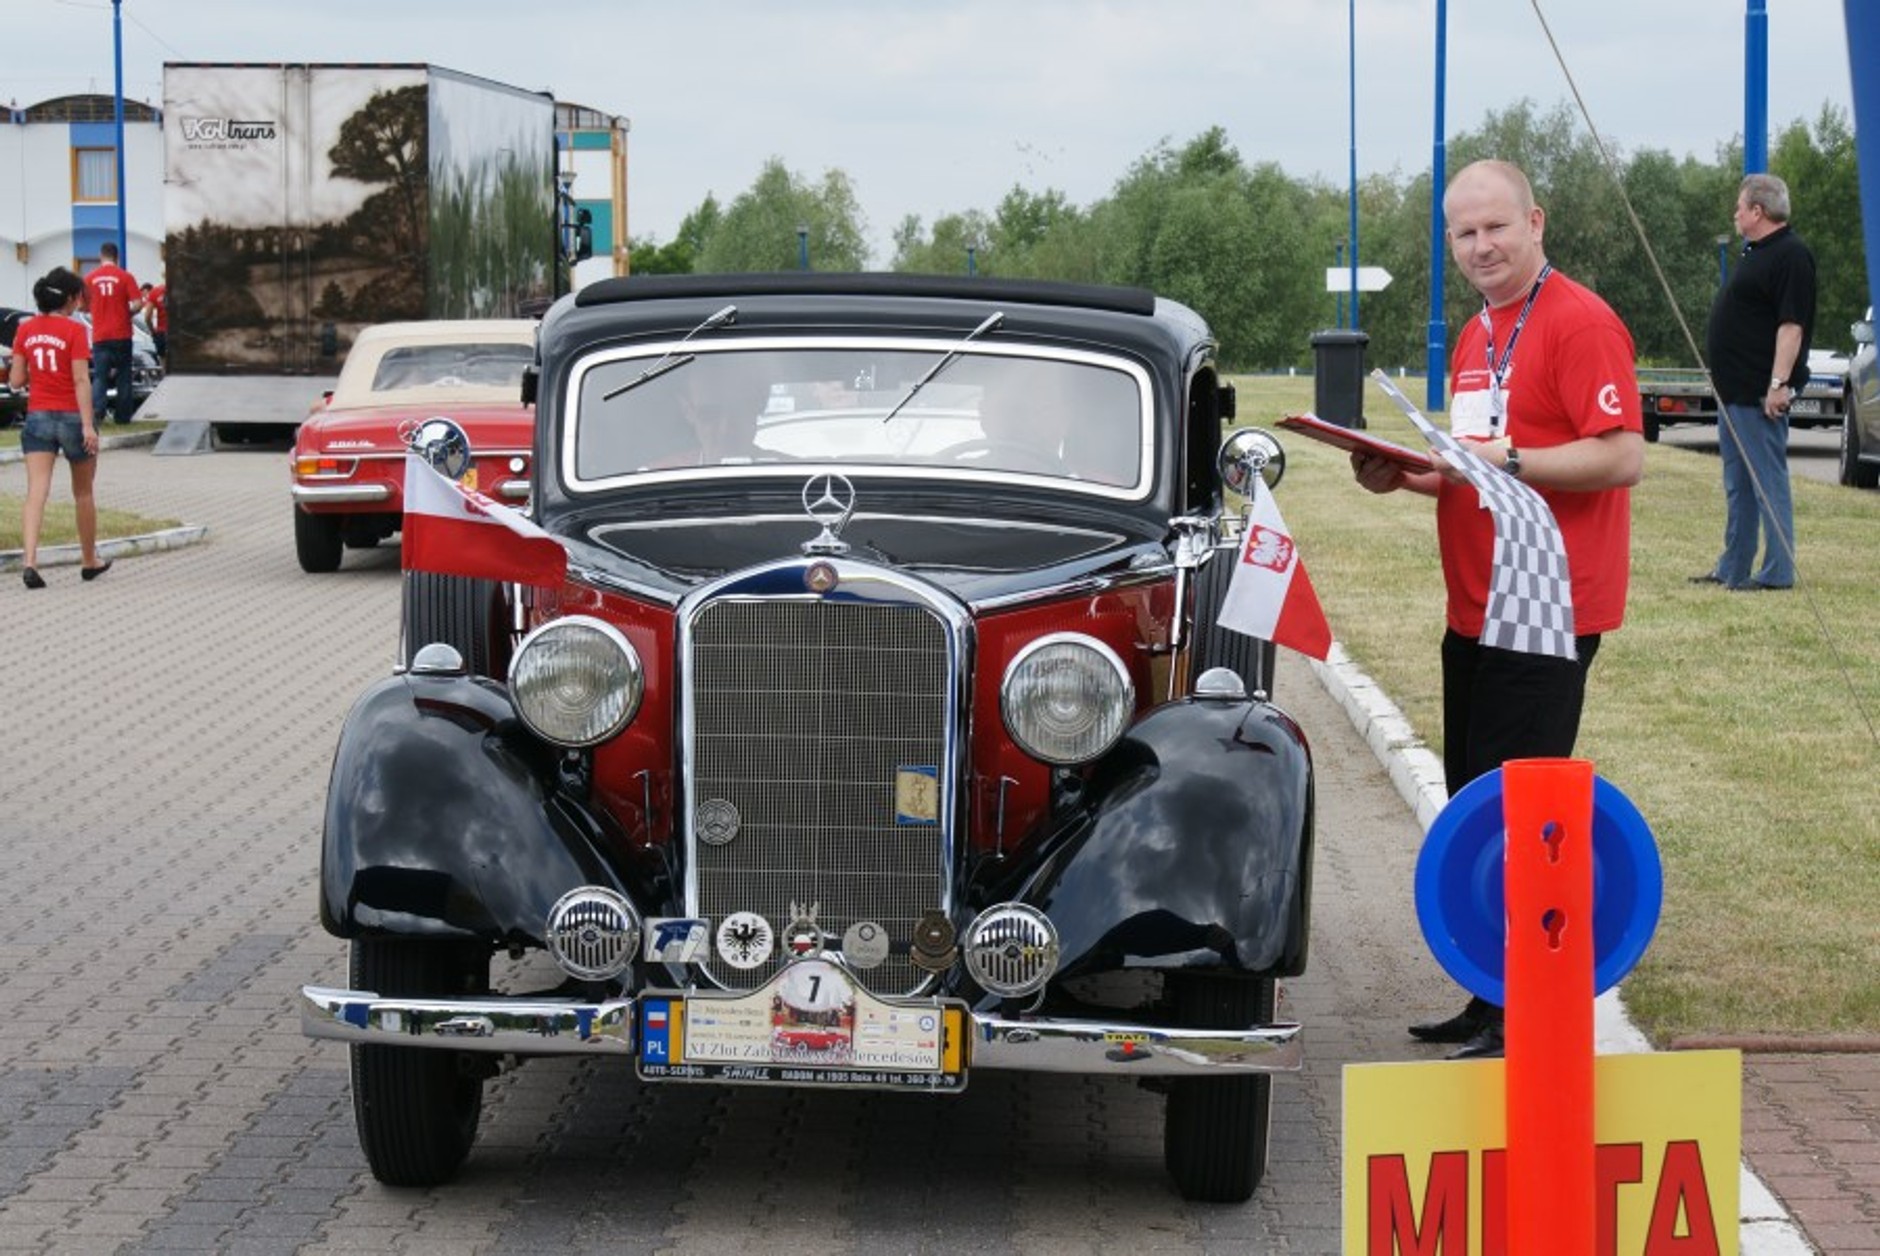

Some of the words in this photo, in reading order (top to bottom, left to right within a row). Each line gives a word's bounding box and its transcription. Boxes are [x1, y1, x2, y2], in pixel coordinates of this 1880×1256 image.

[98, 282, 112, 296] 11
[33, 347, 57, 371] 11
[808, 976, 822, 1003] 7
[647, 1041, 666, 1055] PL
[710, 1043, 738, 1057] Zlot
